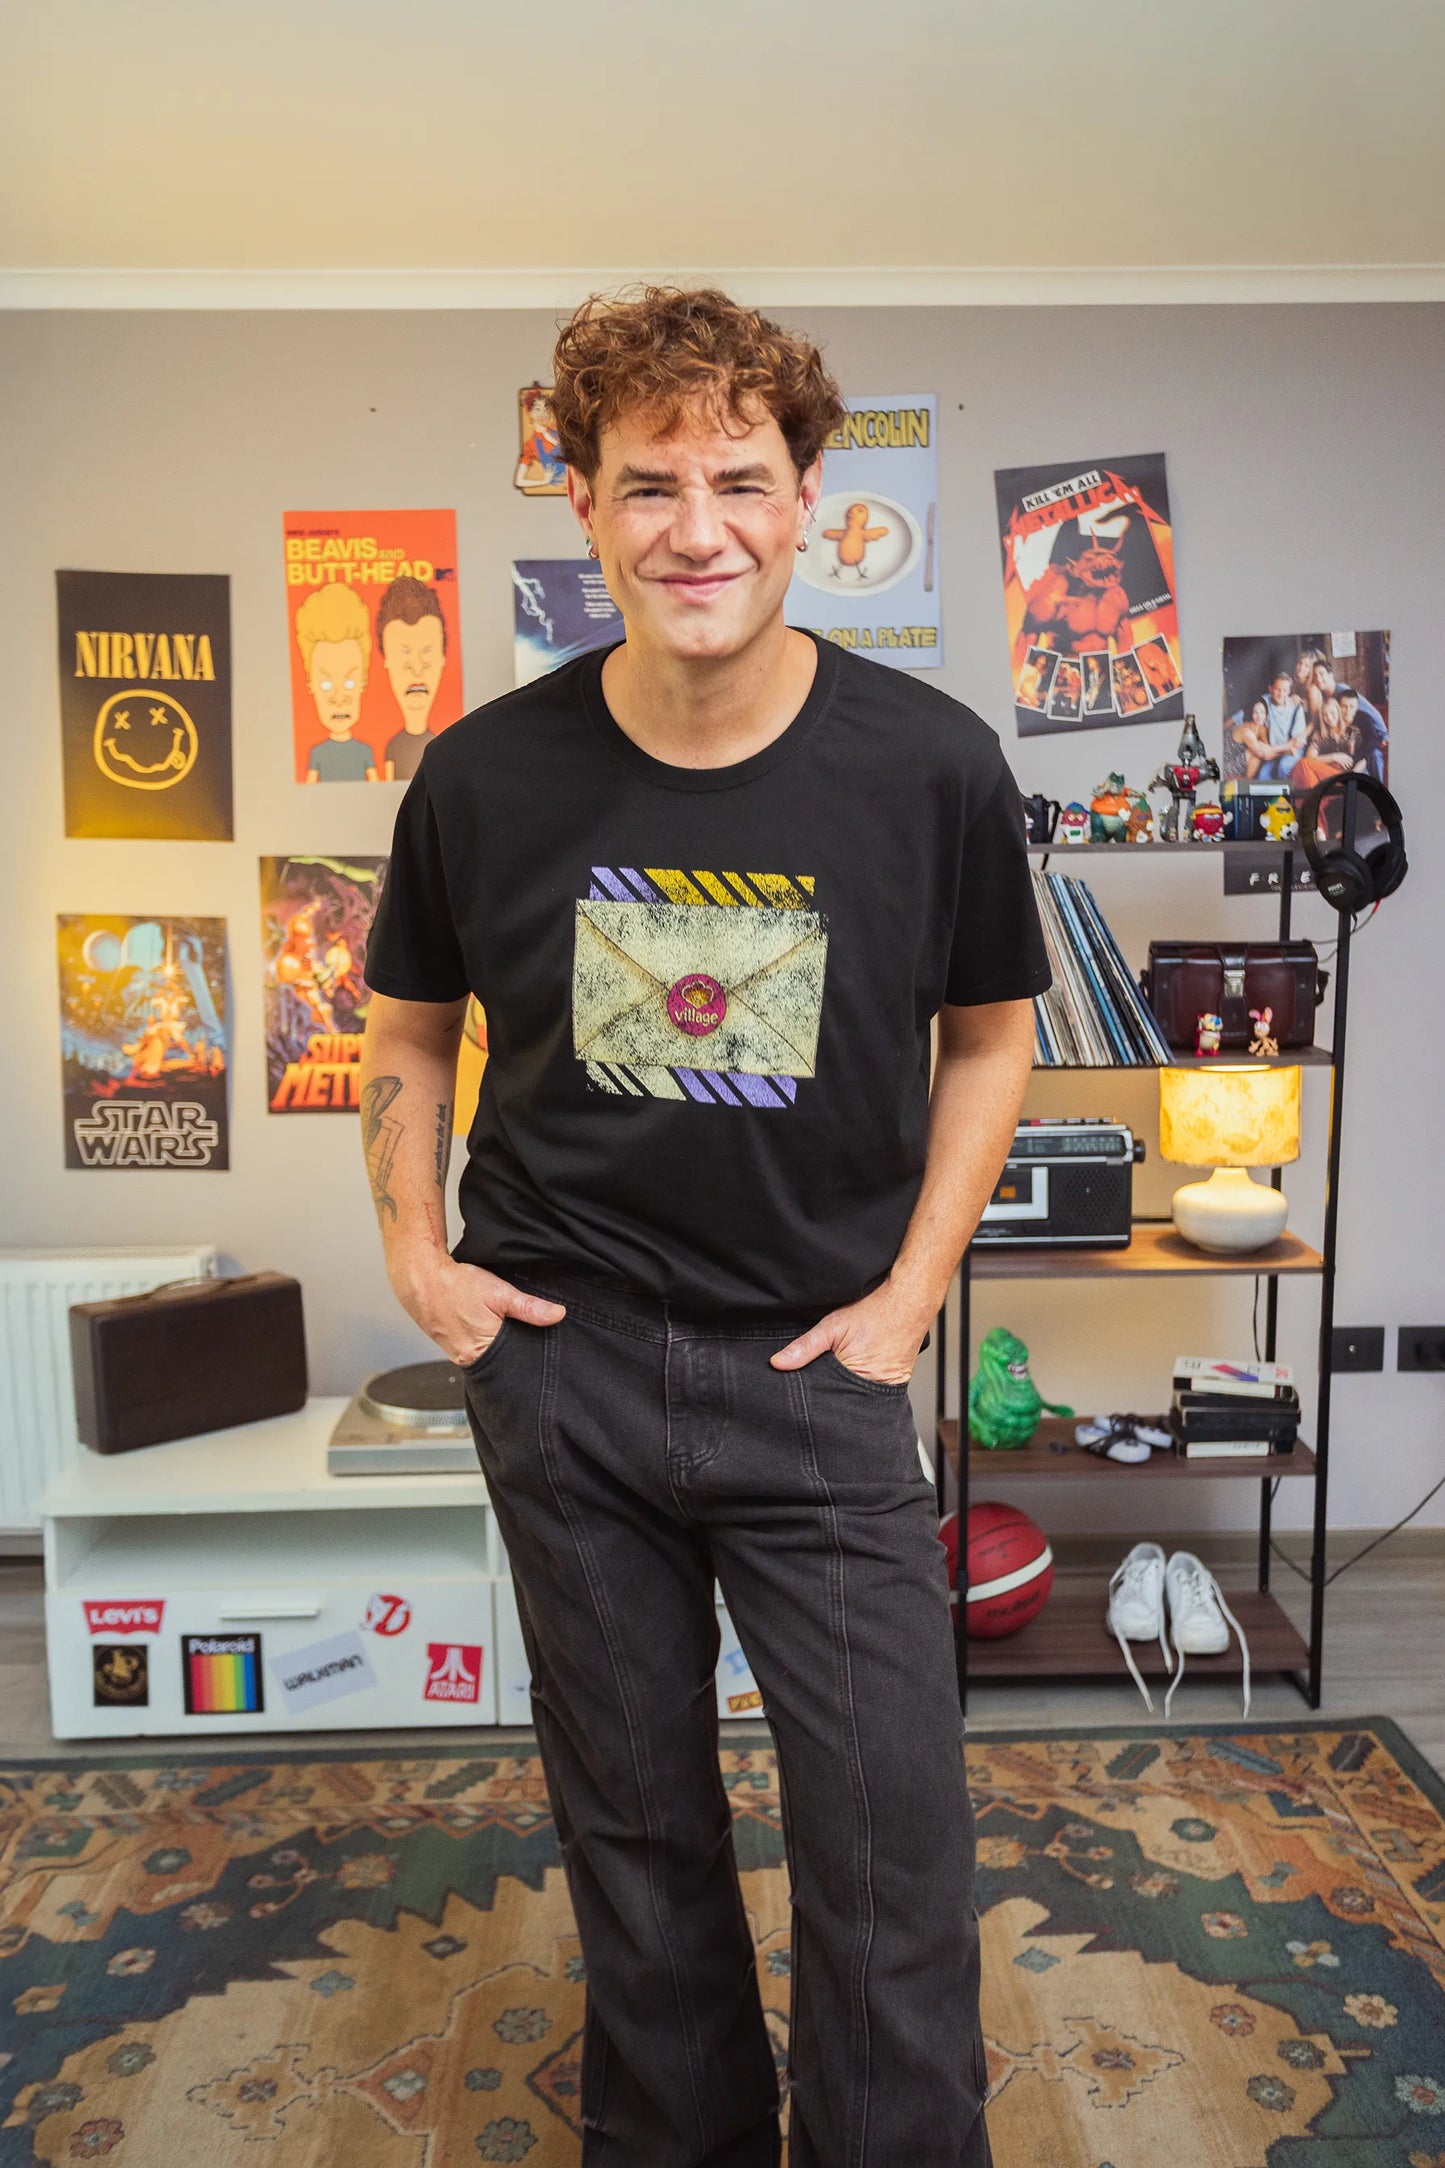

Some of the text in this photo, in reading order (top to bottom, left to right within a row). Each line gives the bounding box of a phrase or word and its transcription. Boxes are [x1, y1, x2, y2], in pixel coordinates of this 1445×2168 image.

[1026, 474, 1099, 508] KILL 'EM ALL
[286, 537, 378, 561] BEAVIS
[287, 560, 434, 585] BUTT-HEAD
[828, 627, 858, 649] ON
[861, 627, 874, 649] A
[876, 626, 937, 649] PLATE
[74, 630, 216, 681] NIRVANA
[674, 1006, 719, 1028] village
[74, 1100, 218, 1134] STAR
[75, 1130, 219, 1166] WARS
[188, 1636, 255, 1655] Polaroid
[427, 1680, 476, 1699] ATARI
